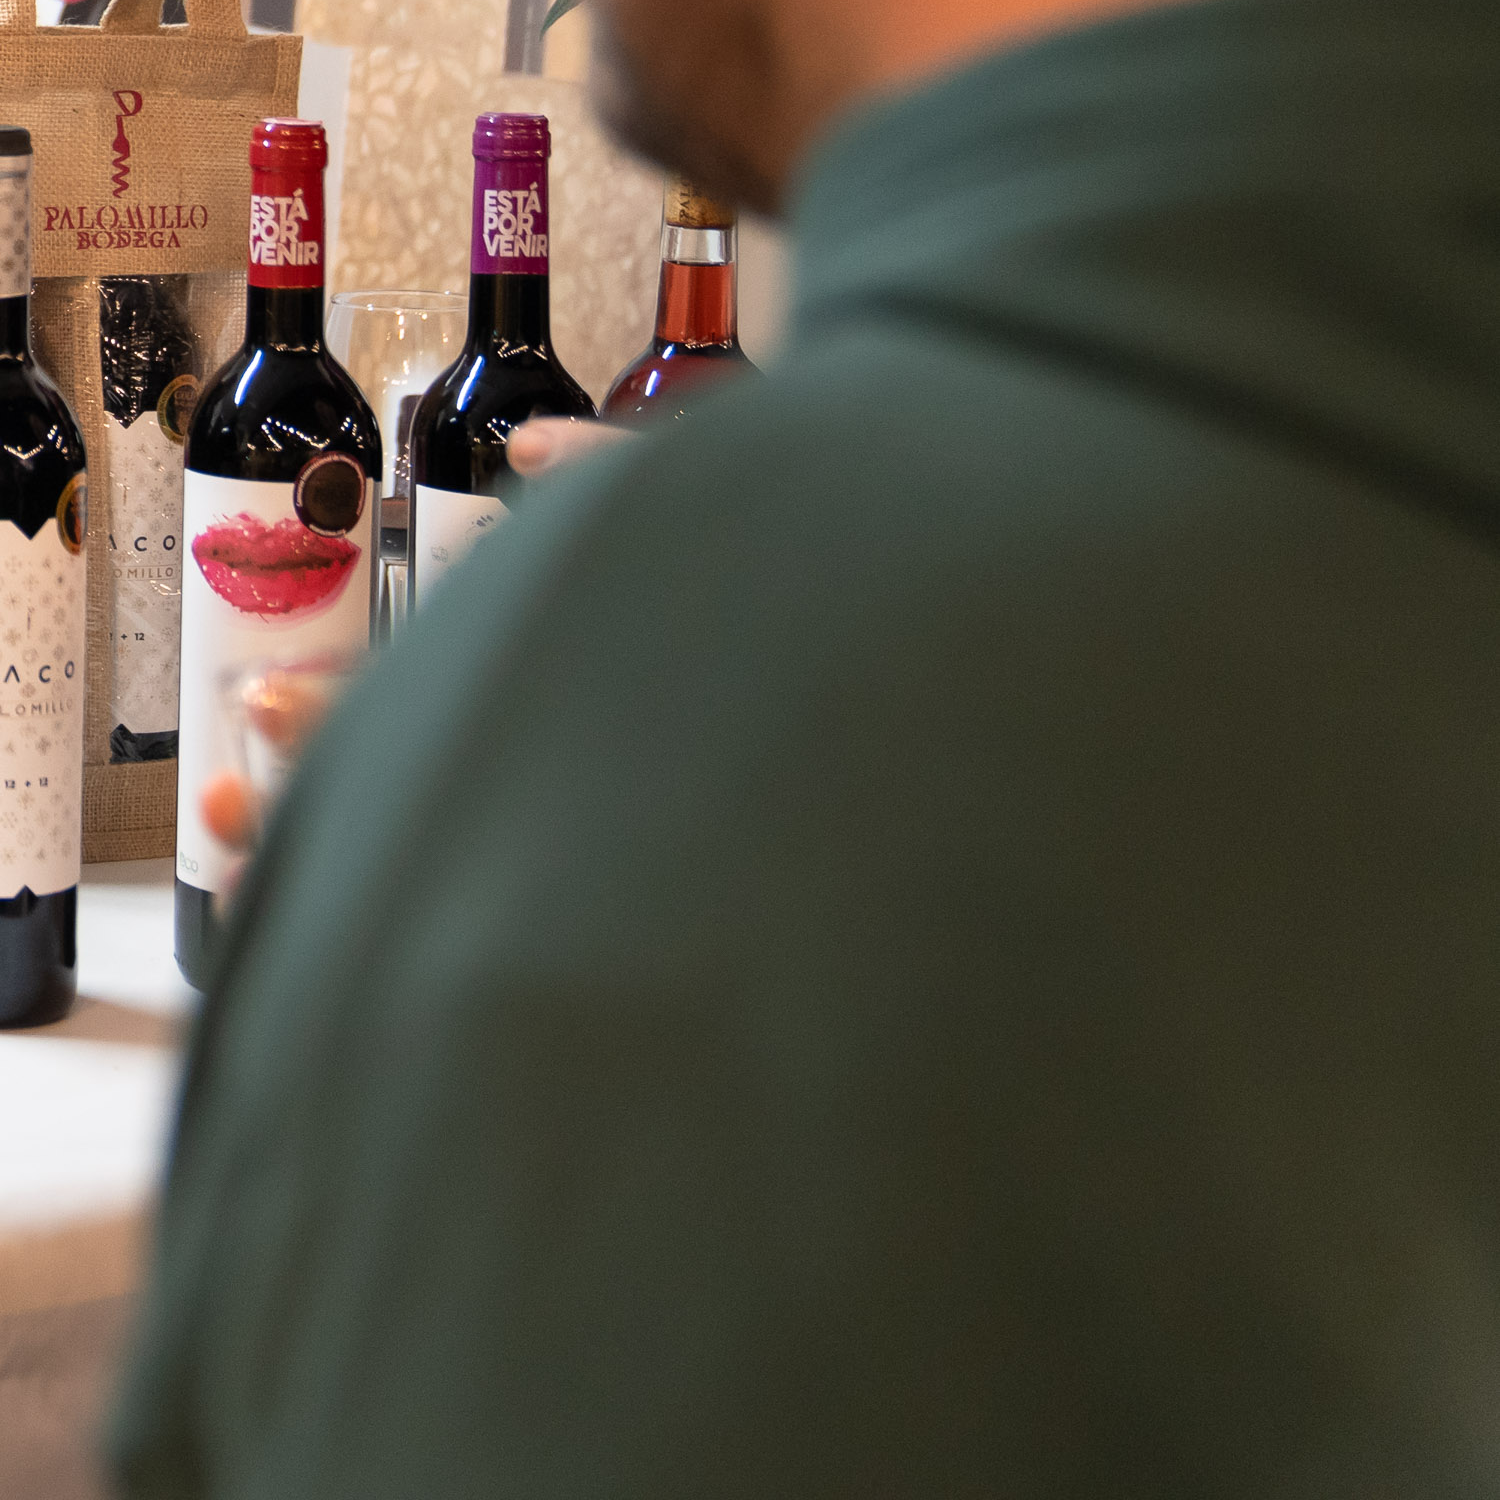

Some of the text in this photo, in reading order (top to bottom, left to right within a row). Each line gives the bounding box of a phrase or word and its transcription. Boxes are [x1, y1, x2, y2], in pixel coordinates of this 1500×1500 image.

[250, 188, 309, 220] ESTÁ
[484, 181, 541, 213] ESTÁ
[43, 203, 208, 231] PALOMILLO
[483, 212, 534, 235] POR
[76, 230, 181, 250] BODEGA
[249, 219, 298, 243] POR
[249, 241, 319, 266] VENIR
[483, 233, 547, 257] VENIR
